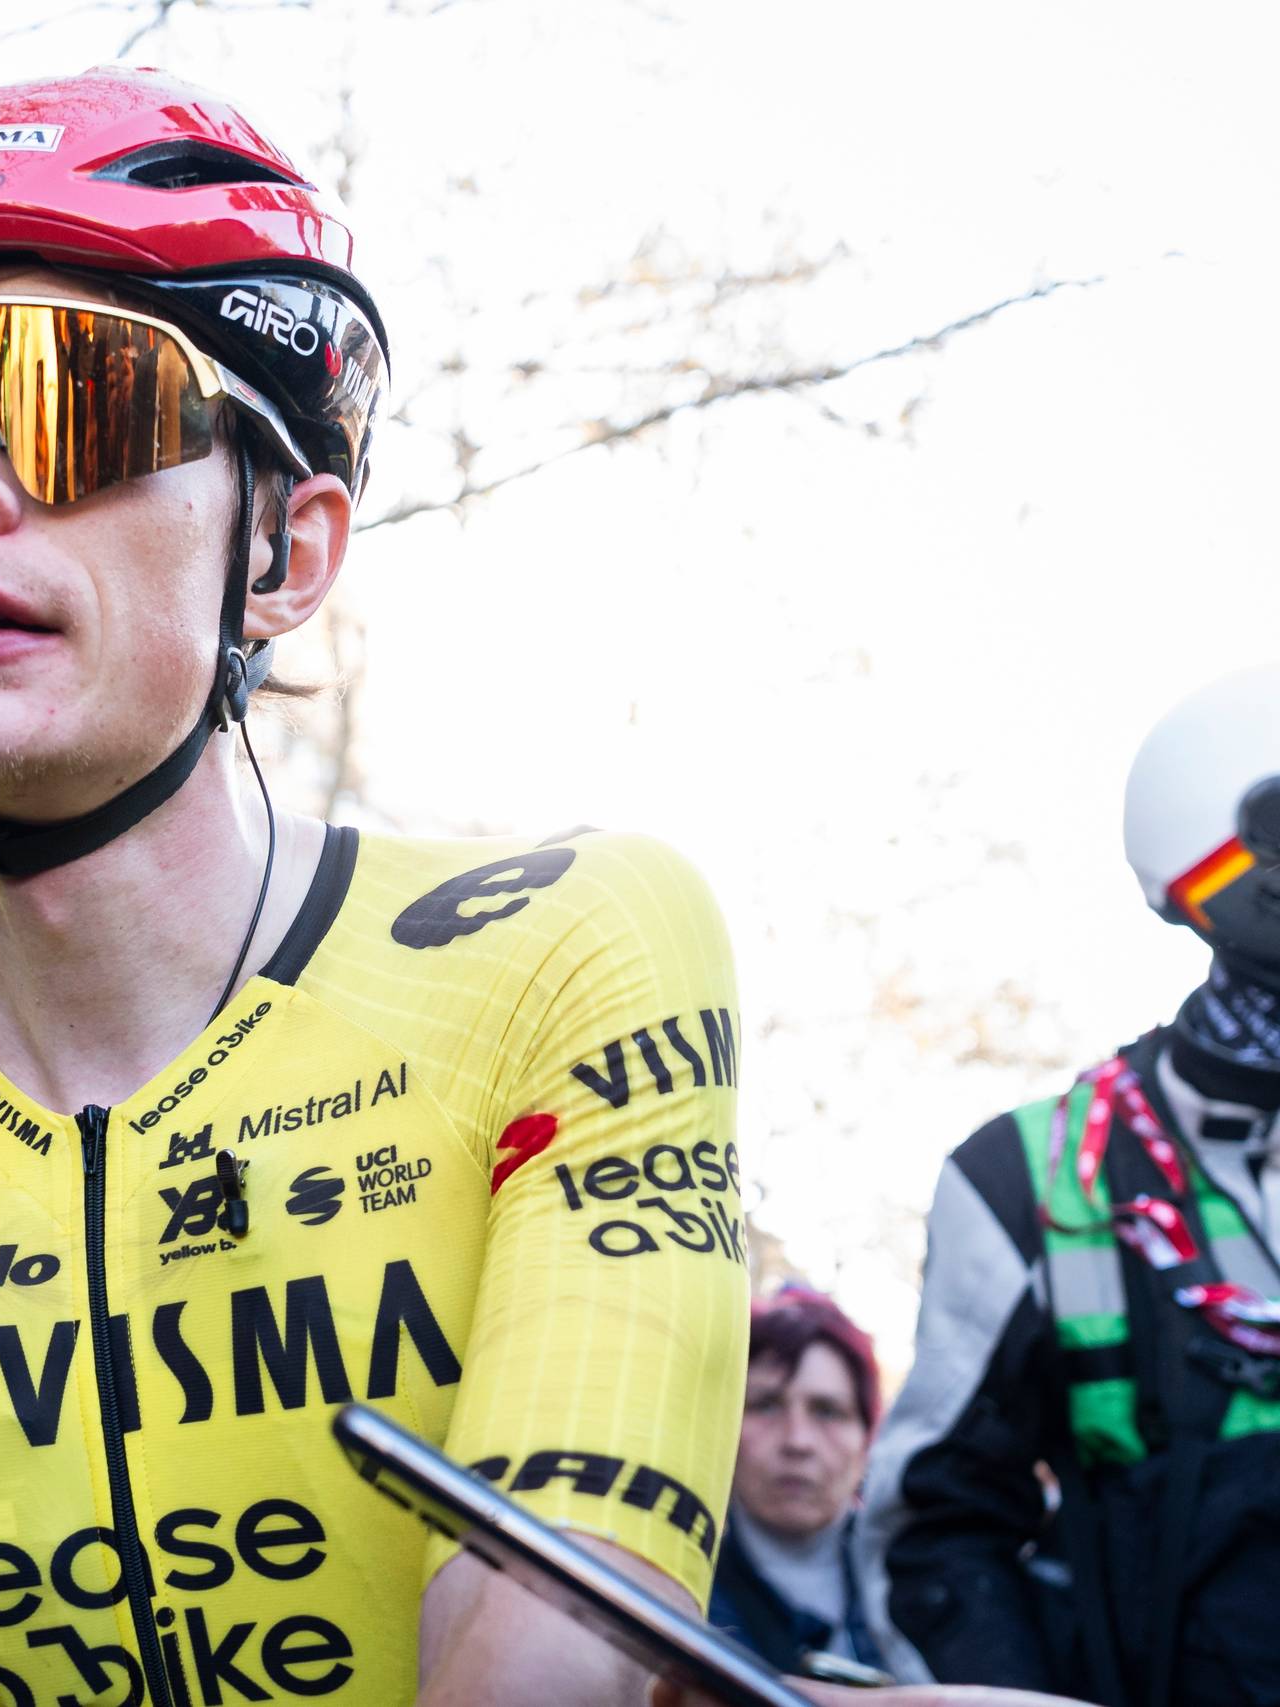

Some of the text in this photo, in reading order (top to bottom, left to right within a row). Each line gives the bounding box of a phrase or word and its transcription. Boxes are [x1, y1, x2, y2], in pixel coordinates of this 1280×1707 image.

[219, 288, 319, 356] GIRO
[569, 1008, 741, 1110] VISM
[128, 1067, 208, 1135] lease
[237, 1062, 407, 1142] Mistral AI
[356, 1145, 397, 1172] UCI
[358, 1158, 432, 1193] WORLD
[359, 1186, 417, 1213] TEAM
[637, 1196, 747, 1266] bik
[159, 1242, 217, 1266] yellow
